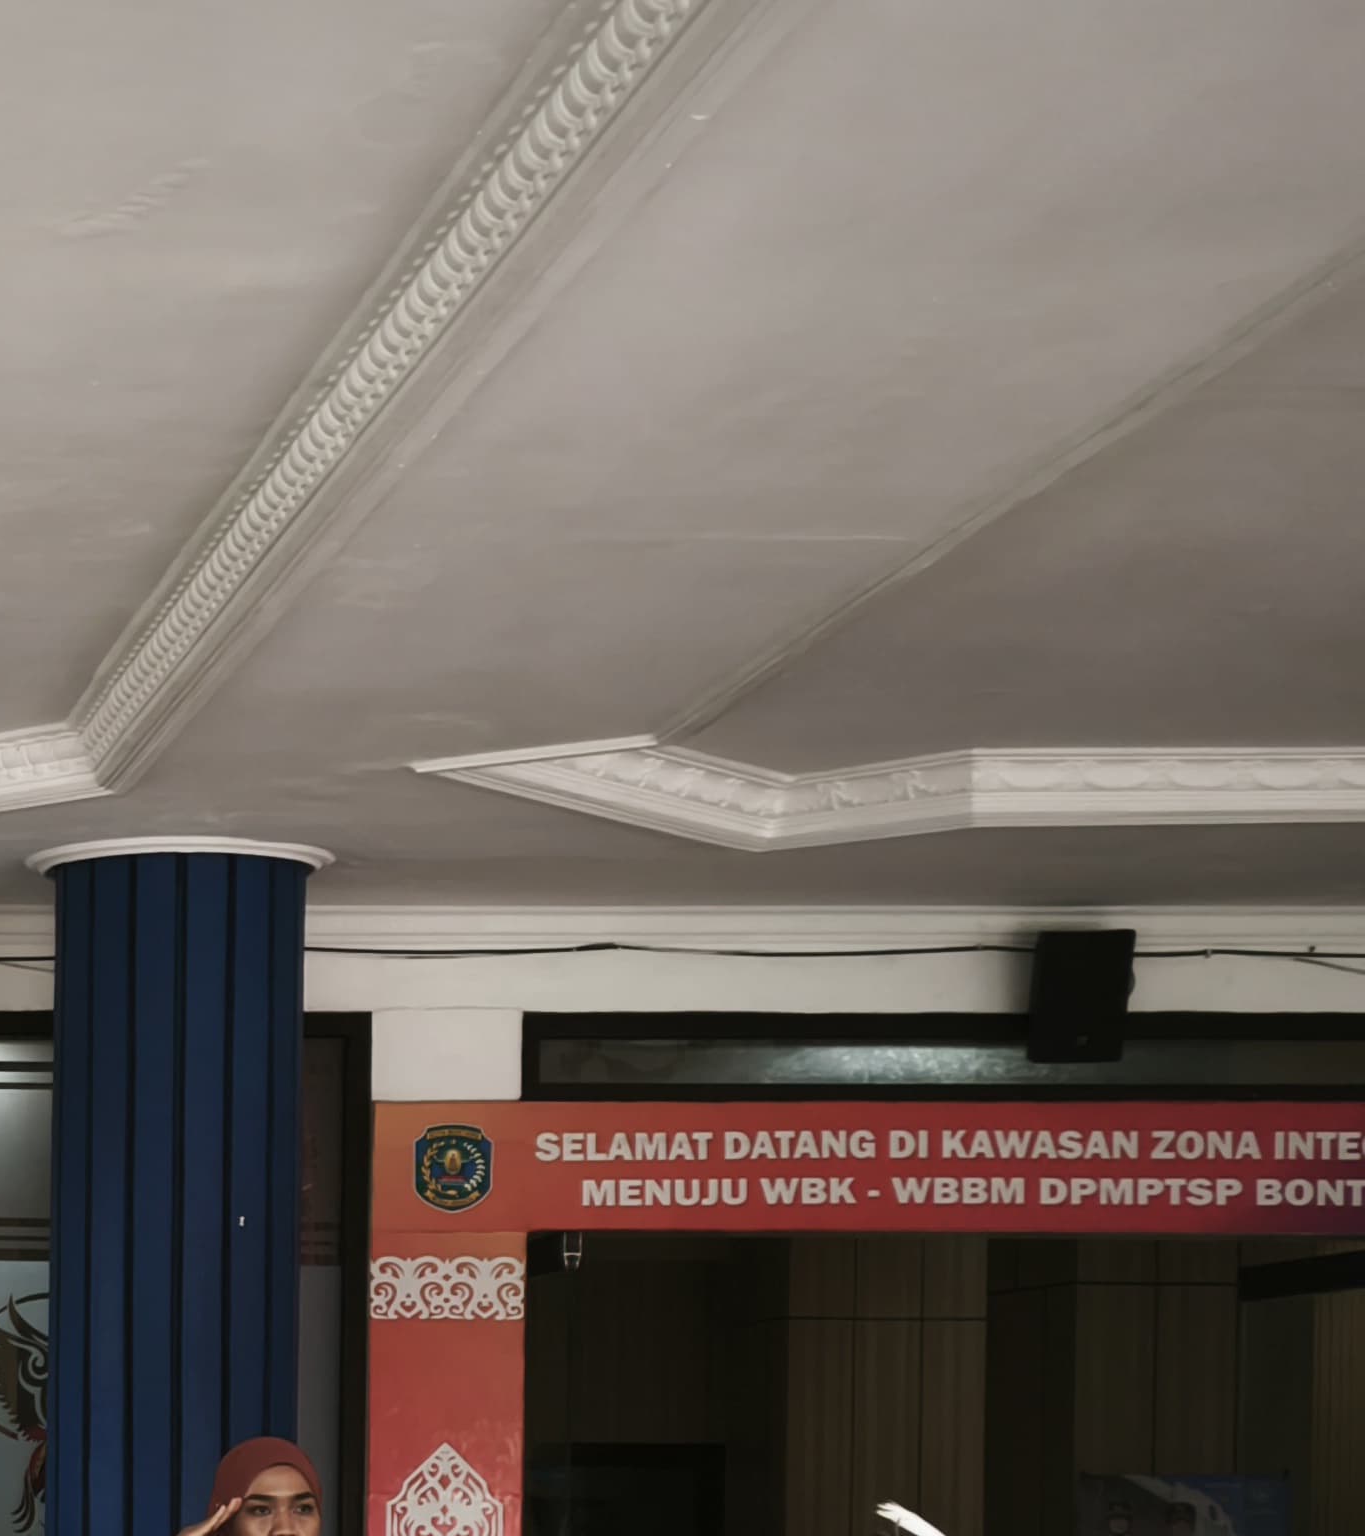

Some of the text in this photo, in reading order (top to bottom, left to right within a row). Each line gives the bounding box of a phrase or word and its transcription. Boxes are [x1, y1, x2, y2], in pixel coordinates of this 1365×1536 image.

[535, 1130, 1365, 1162] SELAMAT DATANG DI KAWASAN ZONA INTE
[581, 1178, 748, 1207] MENUJU
[760, 1177, 857, 1205] WBK
[892, 1177, 1026, 1205] WBBM
[1039, 1178, 1243, 1206] DPMPTSP
